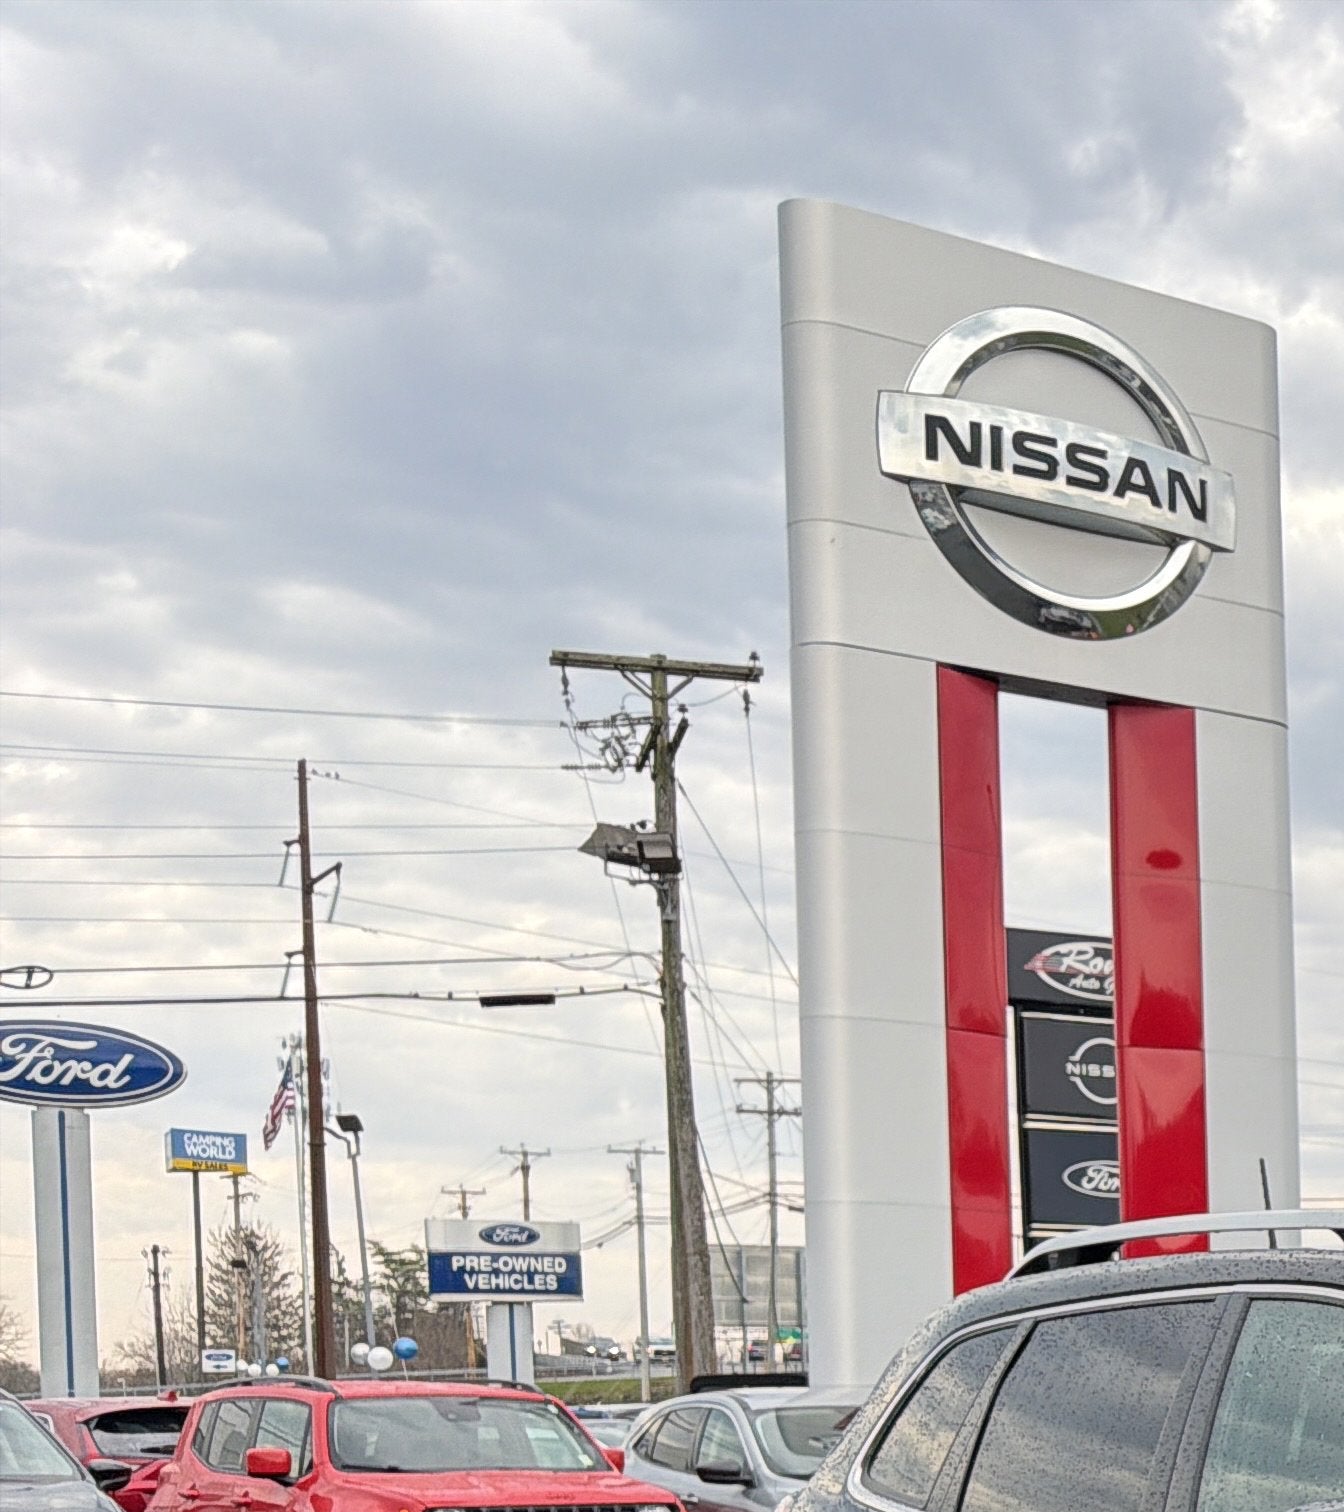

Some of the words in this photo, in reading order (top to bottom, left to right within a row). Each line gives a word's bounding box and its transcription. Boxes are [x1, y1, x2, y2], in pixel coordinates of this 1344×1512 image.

[924, 413, 1207, 523] NISSAN
[0, 1034, 134, 1089] Ford
[184, 1133, 235, 1148] CAMPING
[185, 1142, 236, 1160] WORLD
[493, 1227, 529, 1243] Ford
[451, 1256, 567, 1273] PRE-OWNED
[464, 1273, 558, 1291] VEHICLES
